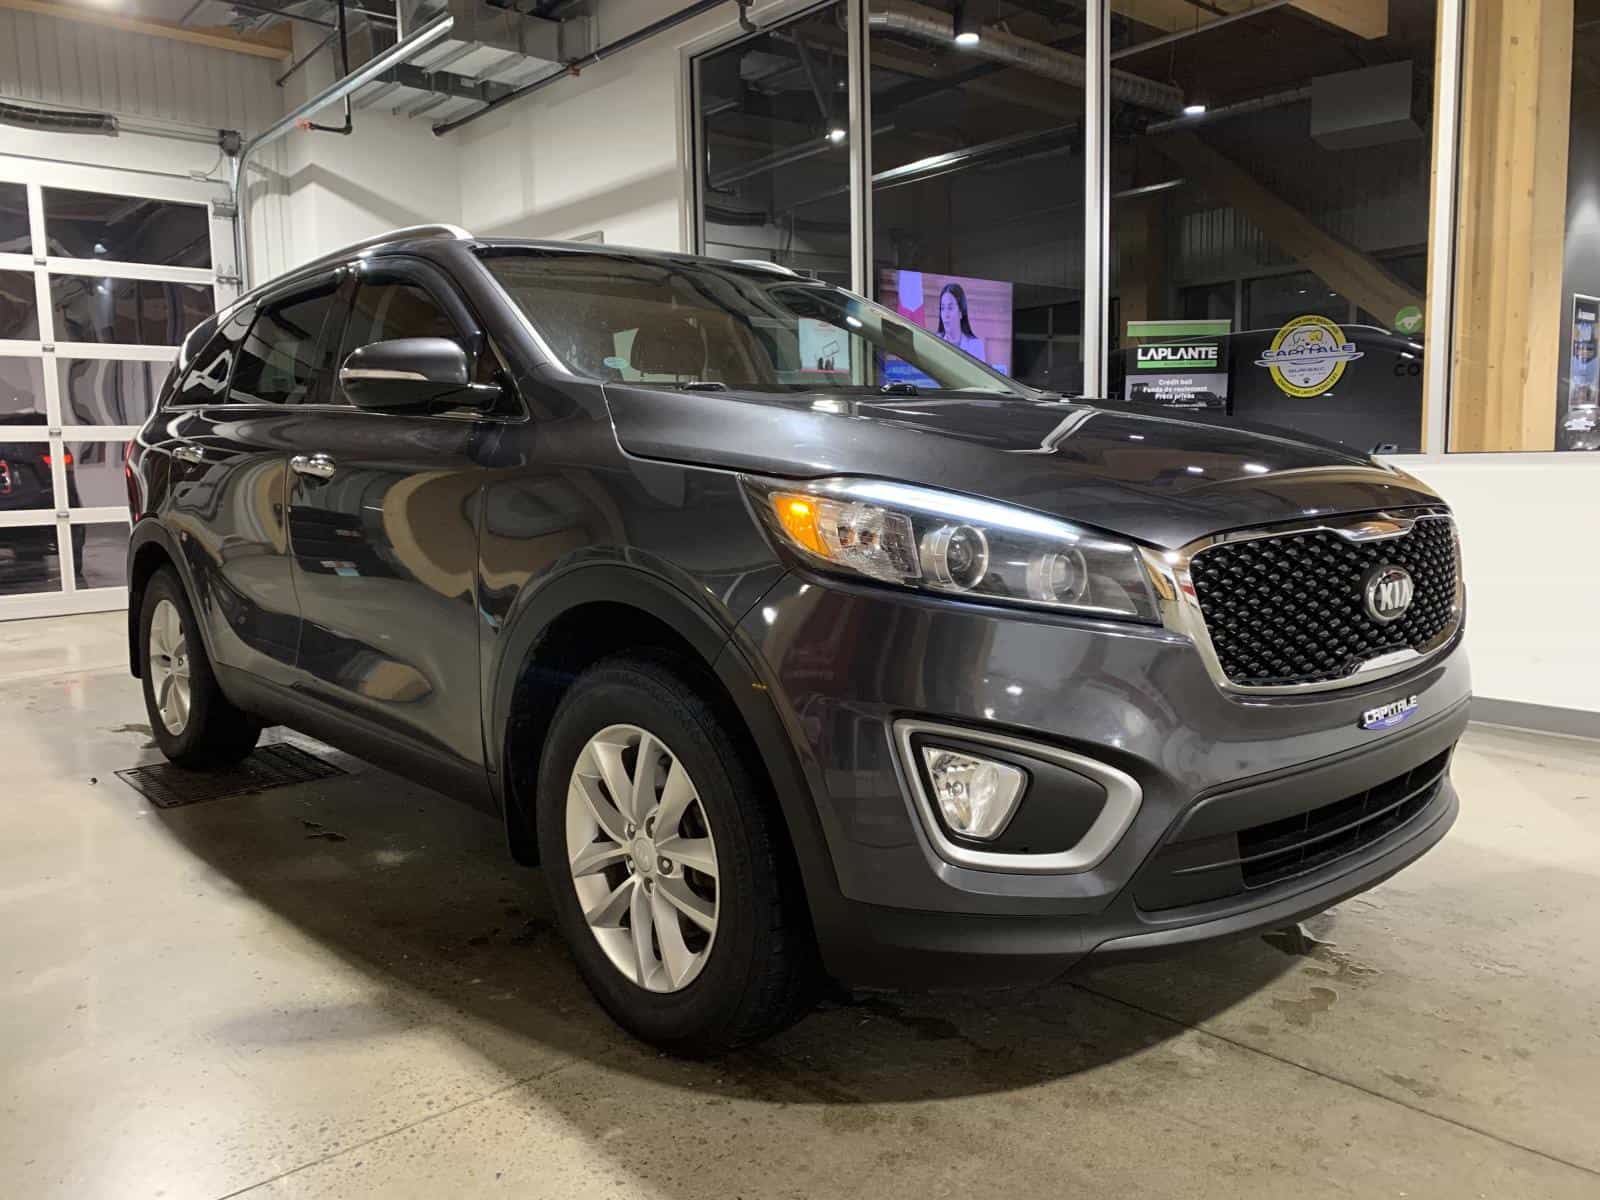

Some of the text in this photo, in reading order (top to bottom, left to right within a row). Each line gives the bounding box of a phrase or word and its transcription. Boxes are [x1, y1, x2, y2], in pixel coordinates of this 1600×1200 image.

[1137, 347, 1218, 360] LAPLANTE
[1263, 344, 1355, 358] CAPITALE
[1379, 578, 1415, 611] KIA
[1364, 695, 1417, 724] CAPITALE
